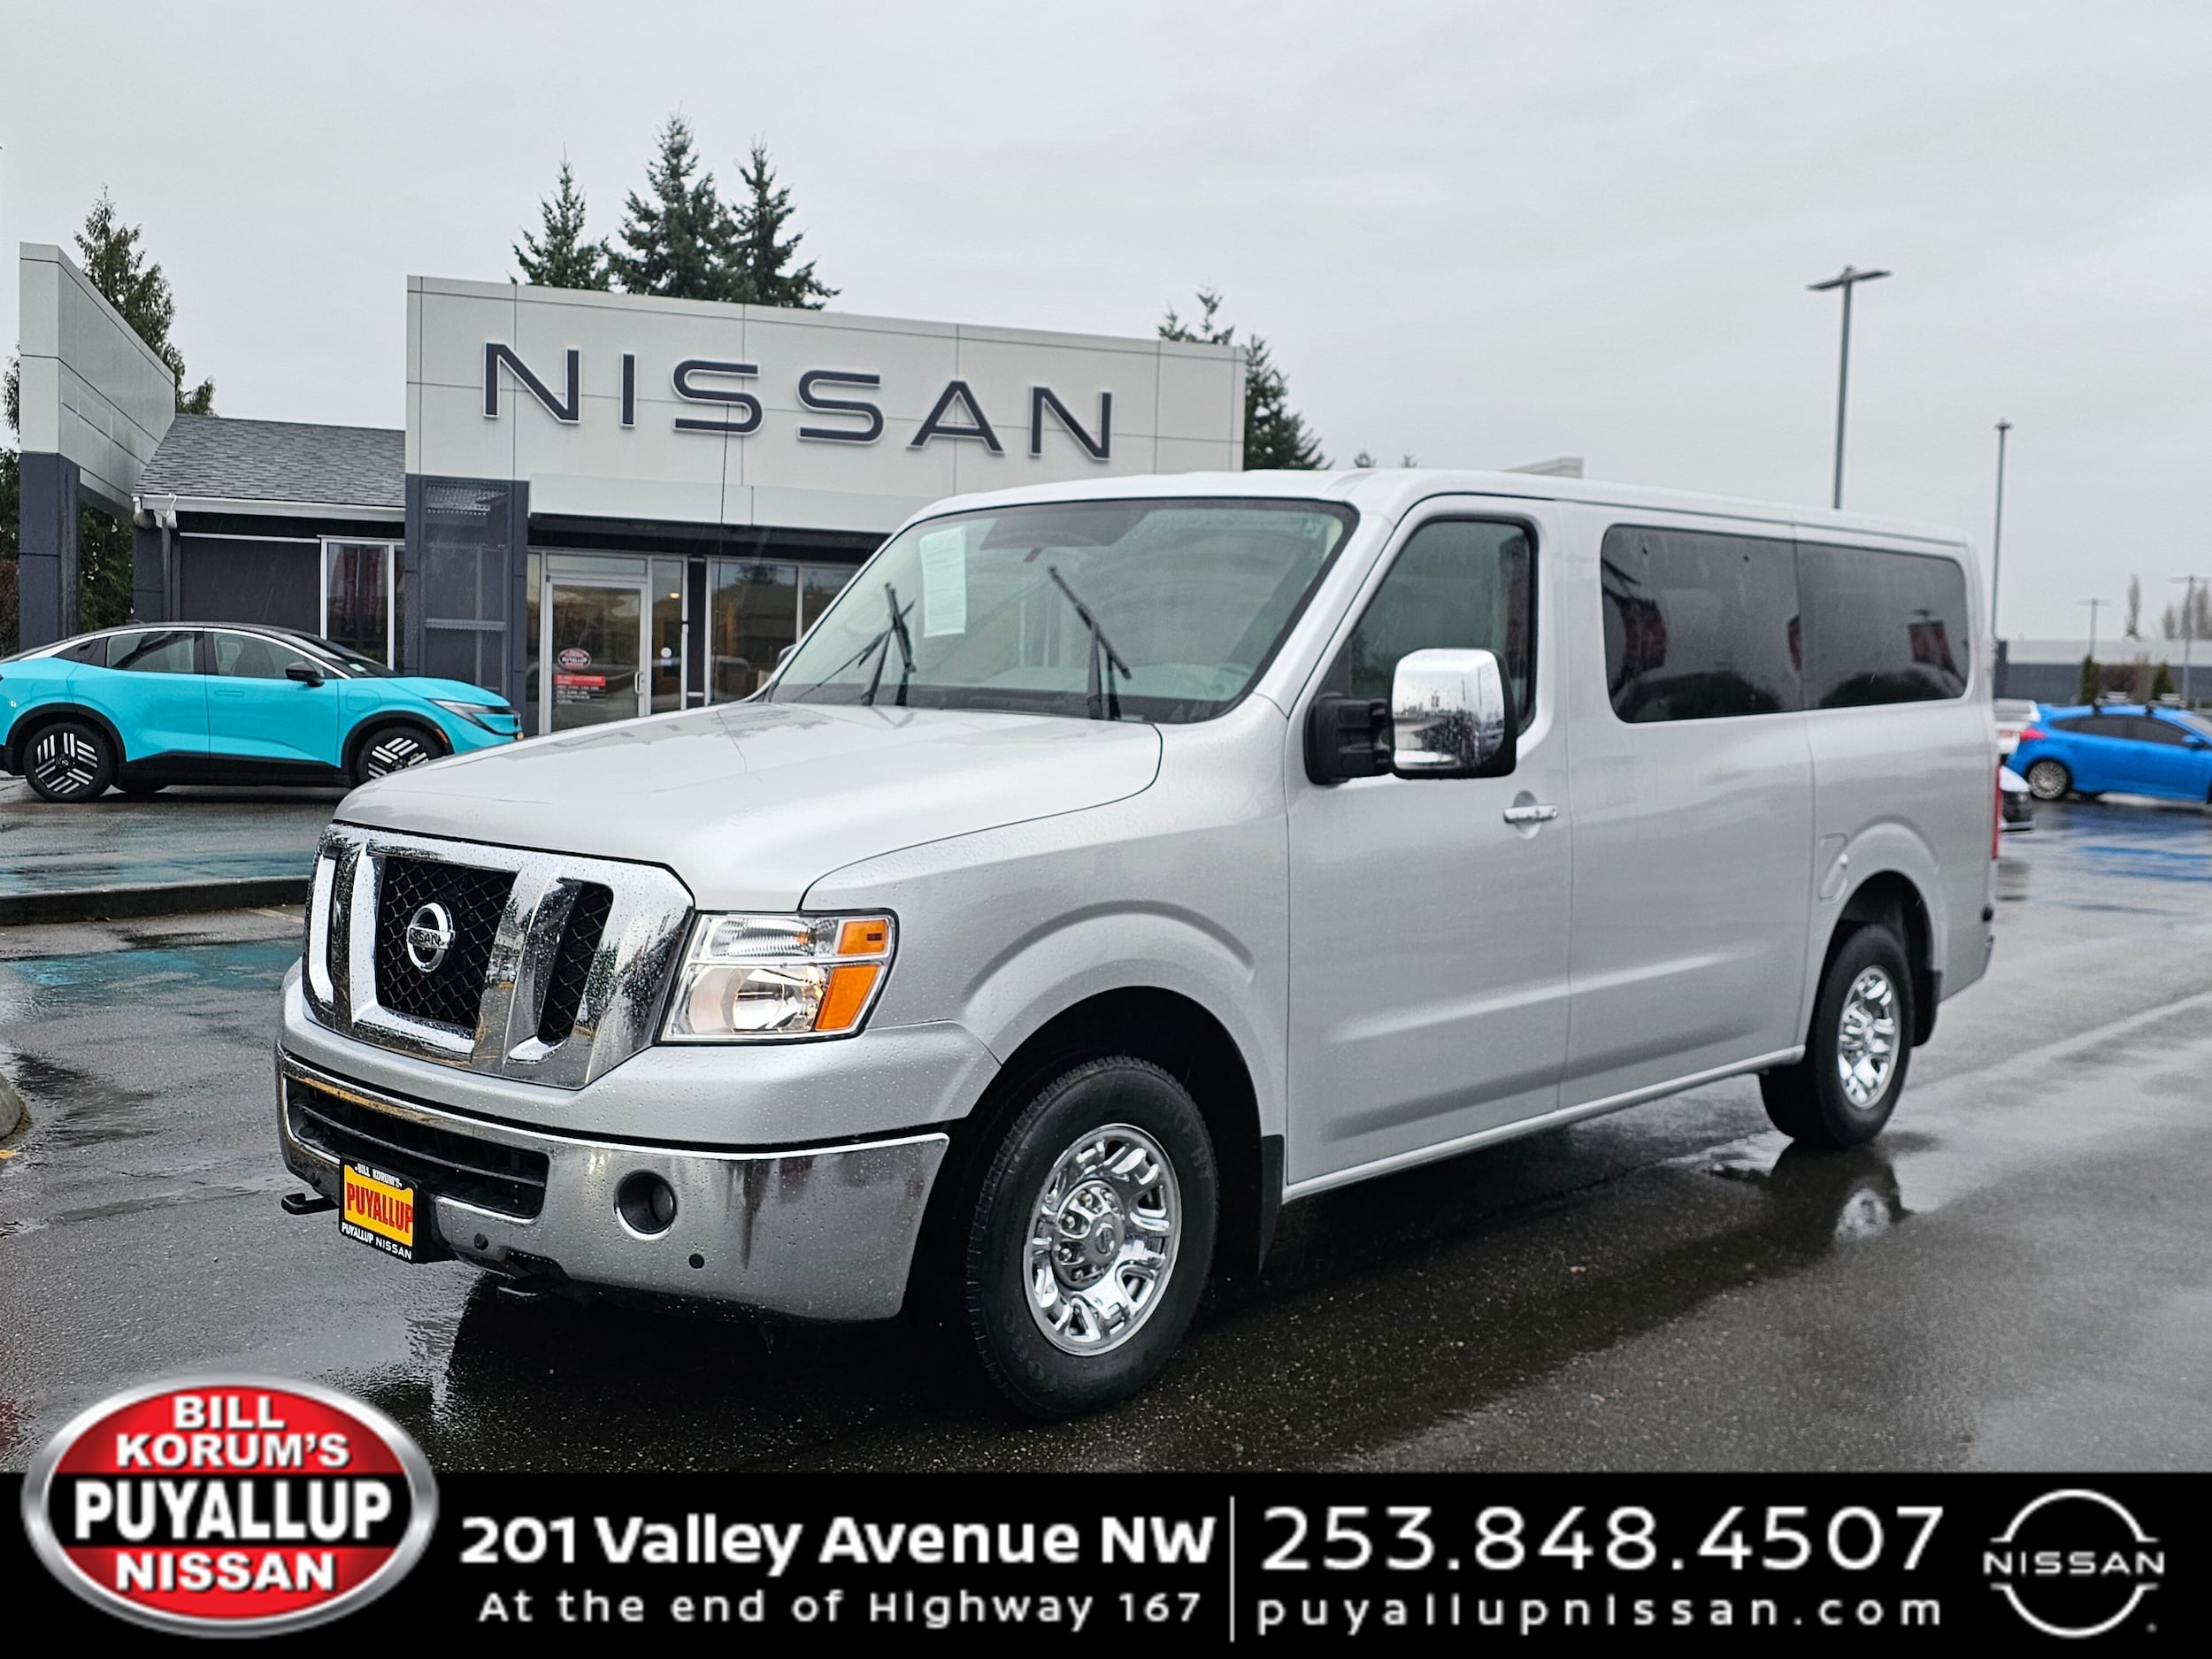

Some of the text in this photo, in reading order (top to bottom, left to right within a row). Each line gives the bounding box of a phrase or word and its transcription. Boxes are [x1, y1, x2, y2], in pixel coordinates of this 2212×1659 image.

[483, 342, 1113, 460] NISSAN
[346, 1182, 413, 1234] PUYALLUP
[342, 1222, 412, 1261] PUYALLUP NISSAN
